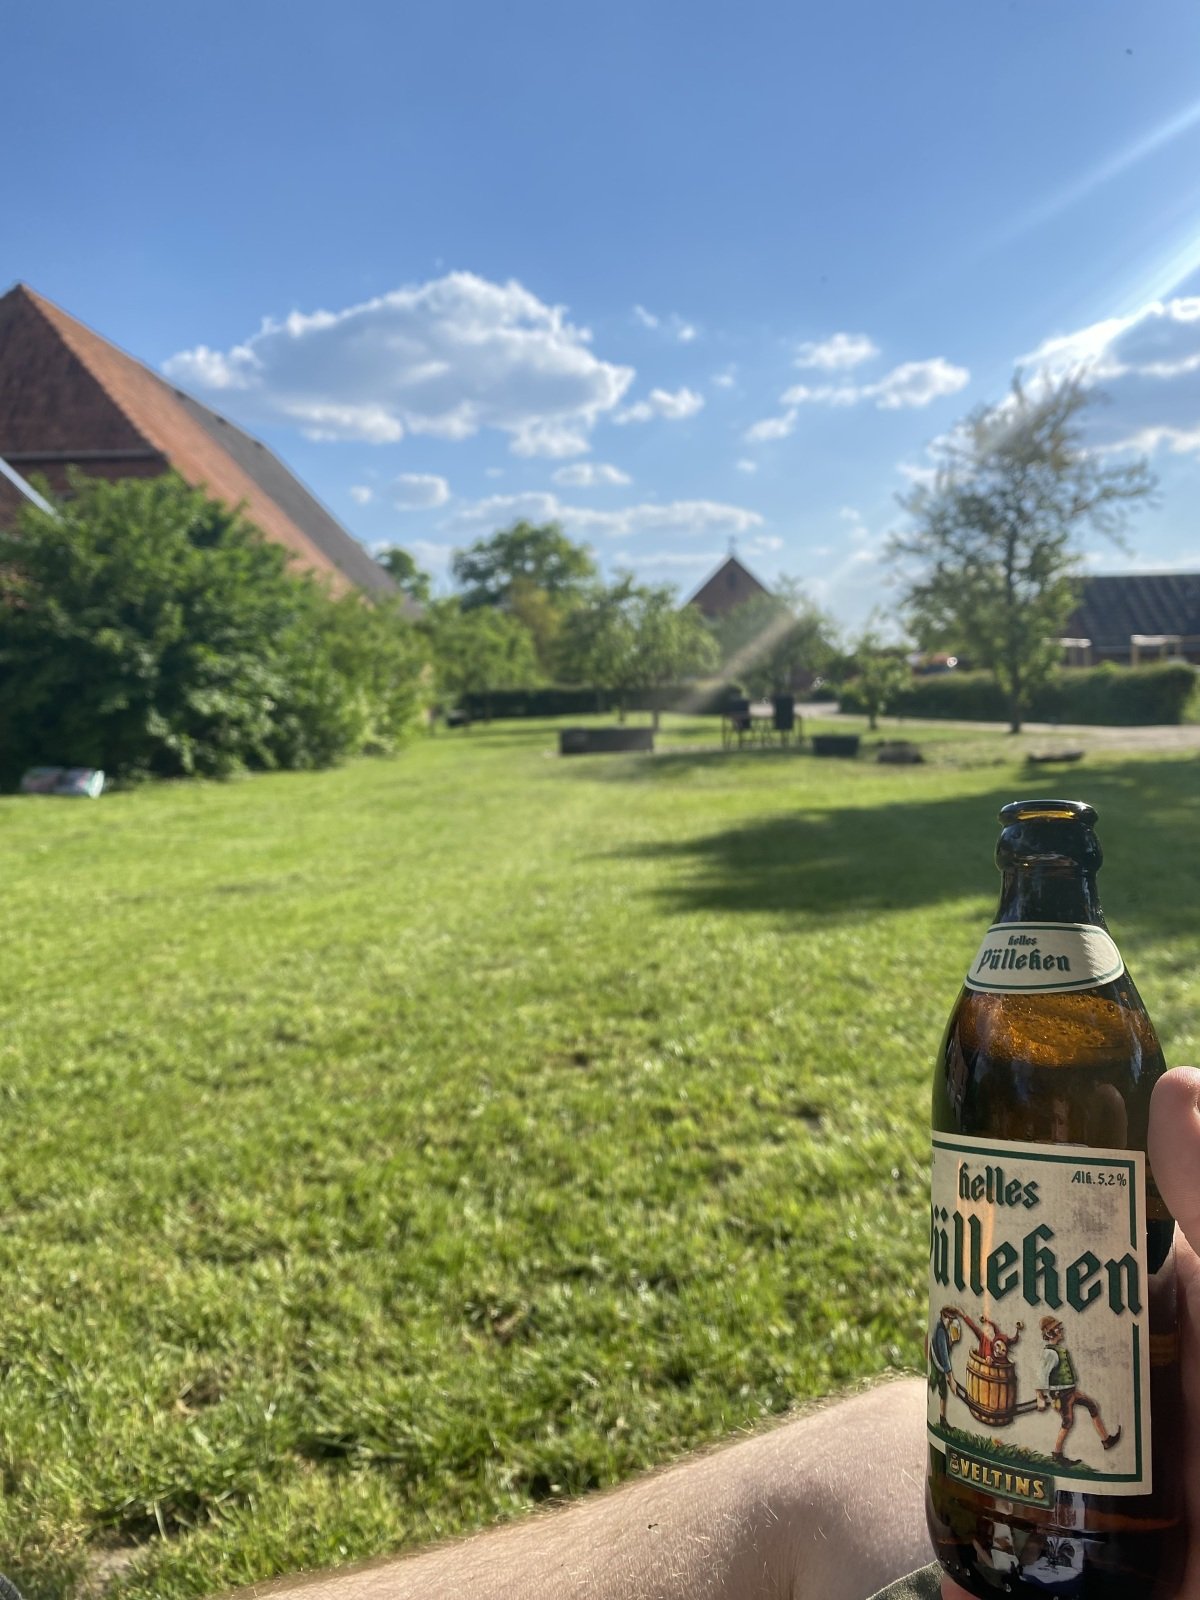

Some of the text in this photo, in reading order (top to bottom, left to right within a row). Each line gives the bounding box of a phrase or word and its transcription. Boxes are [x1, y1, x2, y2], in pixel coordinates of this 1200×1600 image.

[976, 948, 1070, 974] Pülleken
[1008, 935, 1037, 946] helles
[959, 1162, 1040, 1209] helles
[930, 1204, 1142, 1316] ülleken
[959, 1458, 1045, 1499] VELTINS
